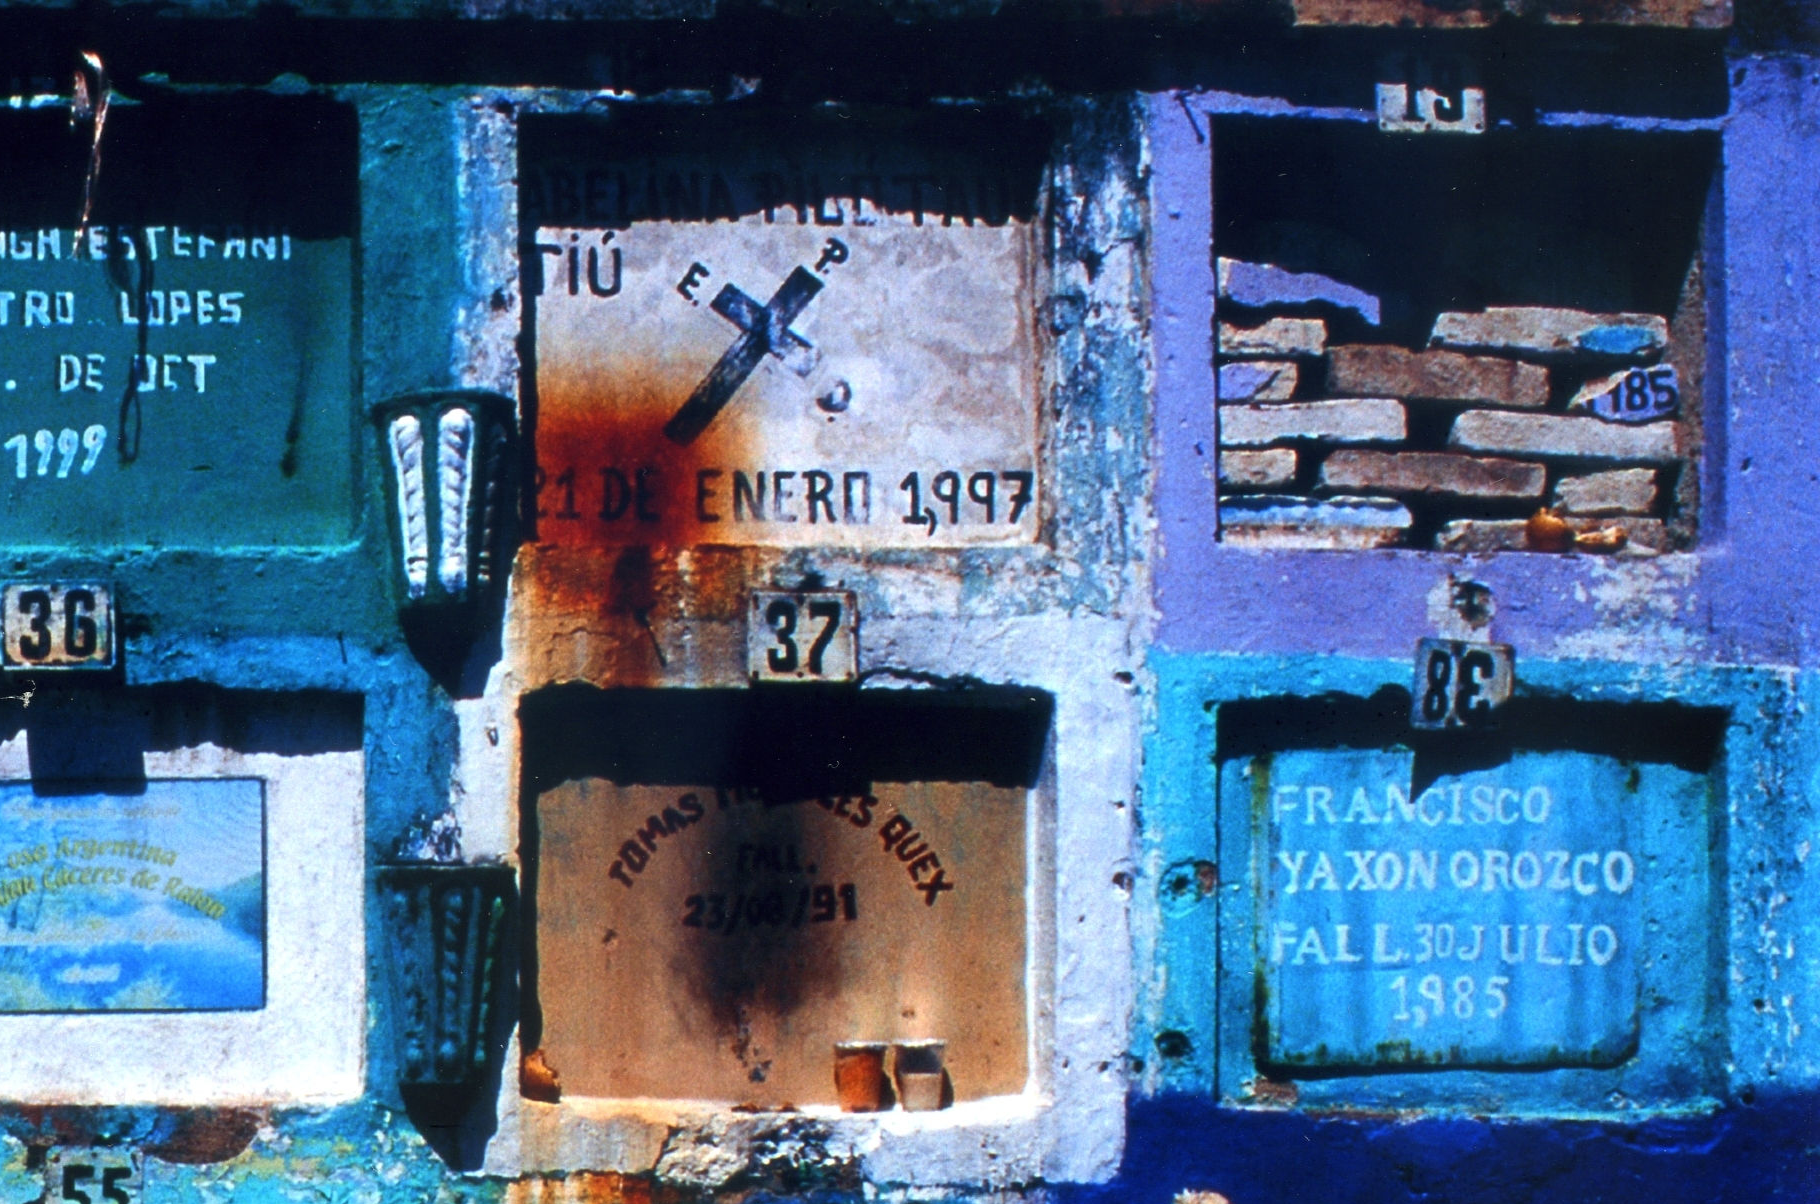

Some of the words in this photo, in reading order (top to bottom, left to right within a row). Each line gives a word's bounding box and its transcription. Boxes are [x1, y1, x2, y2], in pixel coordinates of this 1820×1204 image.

[120, 289, 246, 326] LOPES
[59, 353, 105, 392] DE
[4, 424, 108, 479] 1999
[600, 467, 660, 522] DE
[697, 469, 871, 524] ENERO
[18, 588, 98, 661] 36
[764, 601, 842, 675] 37
[1271, 784, 1553, 827] FRANCISCO
[609, 793, 706, 887] TOMAS
[879, 814, 954, 906] QUEX
[1278, 850, 1438, 894] YAXON
[1449, 850, 1635, 896] OROZCO
